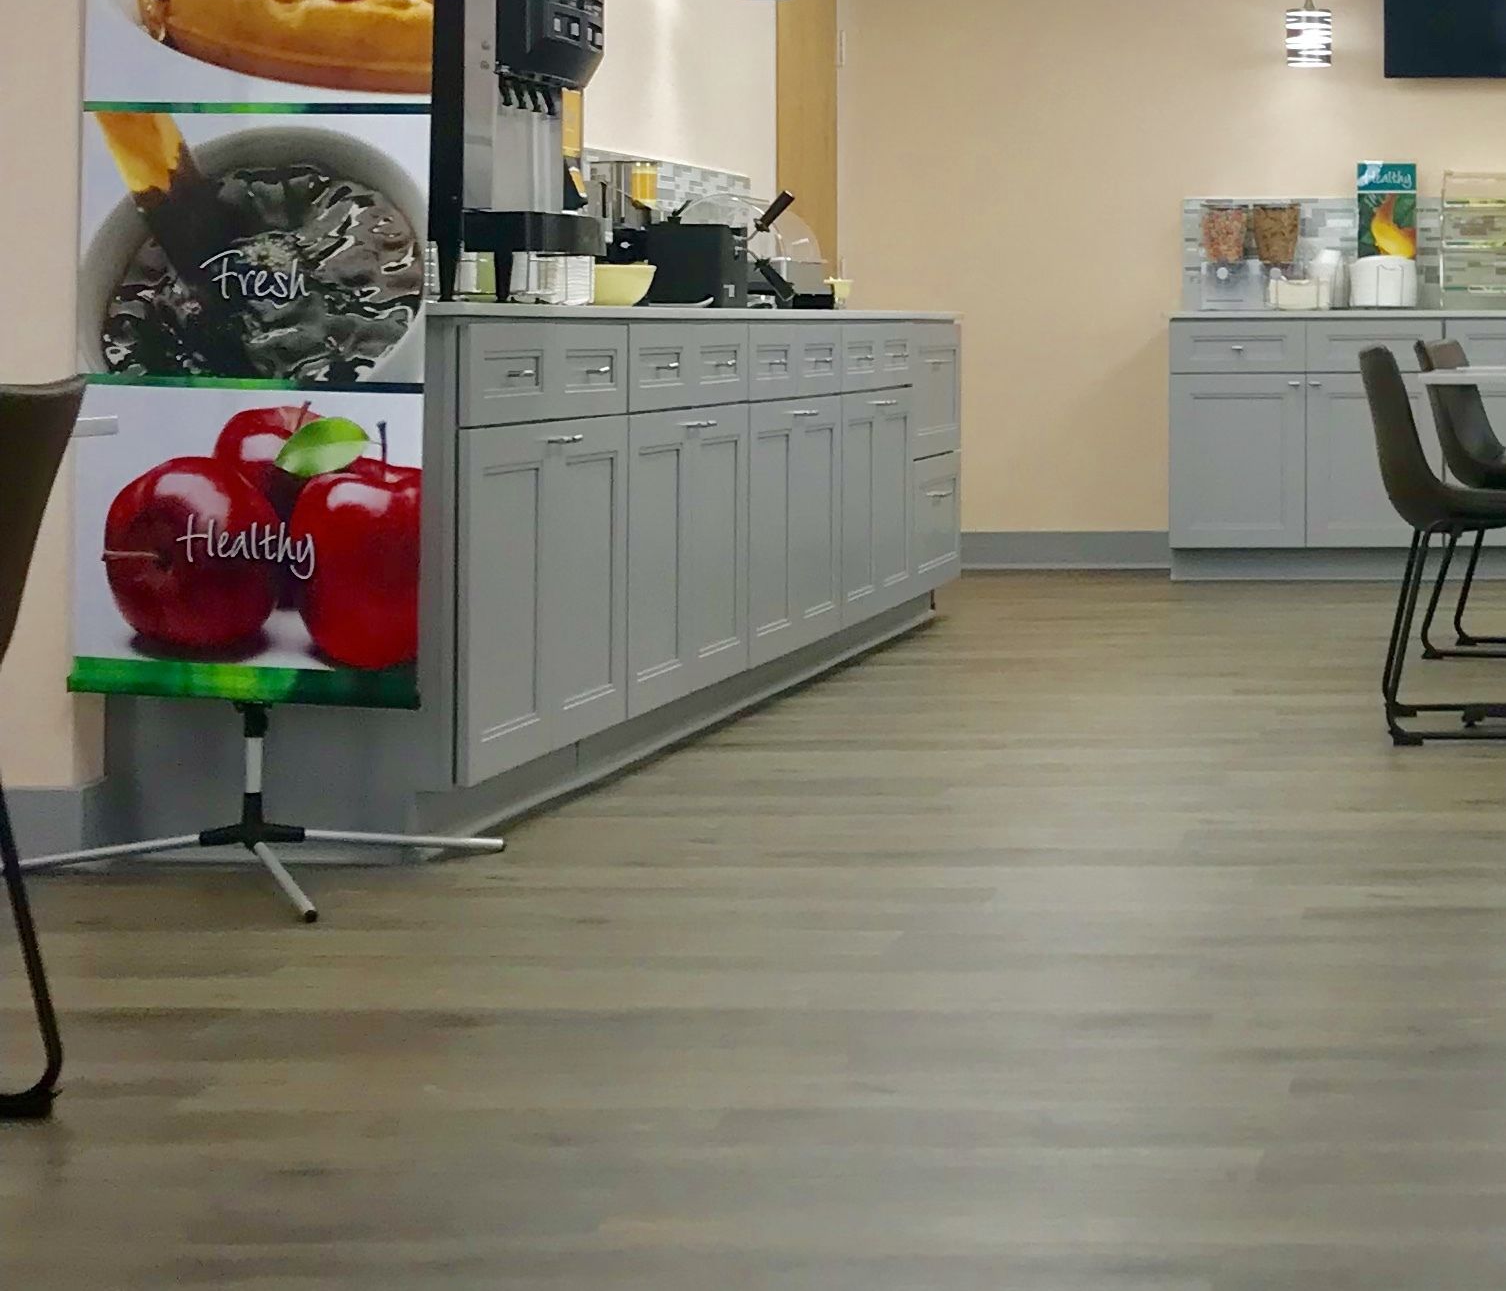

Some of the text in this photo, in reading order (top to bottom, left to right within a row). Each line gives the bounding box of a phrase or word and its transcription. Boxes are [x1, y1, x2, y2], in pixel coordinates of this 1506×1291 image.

[1365, 170, 1413, 189] Healthy
[199, 249, 311, 300] Fresh
[175, 513, 315, 580] Healthy
